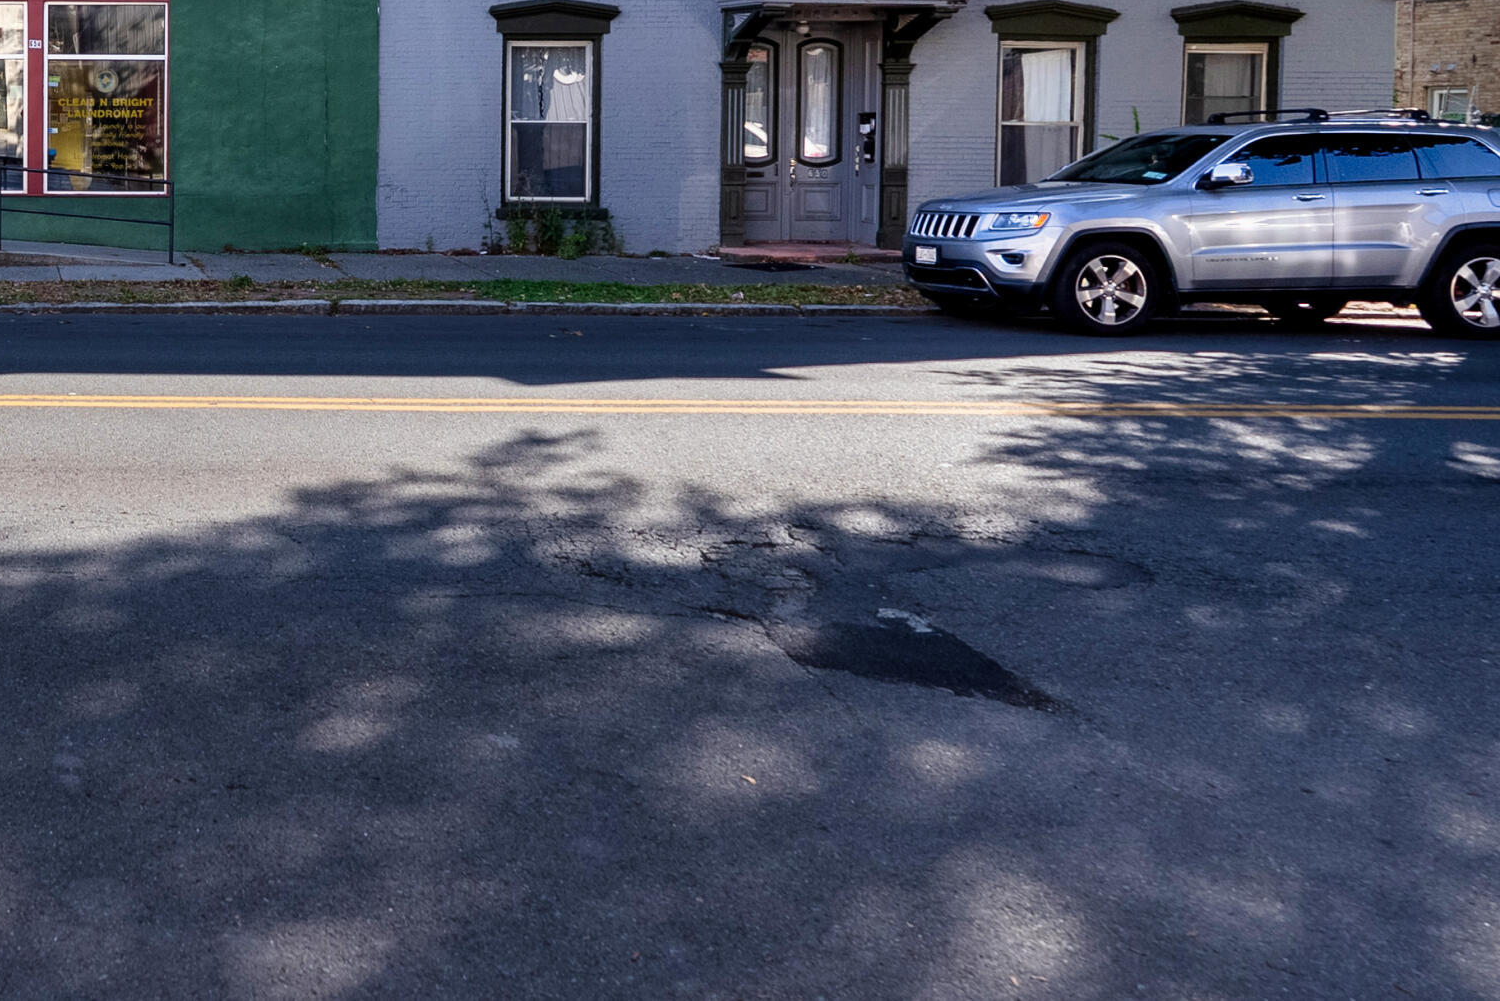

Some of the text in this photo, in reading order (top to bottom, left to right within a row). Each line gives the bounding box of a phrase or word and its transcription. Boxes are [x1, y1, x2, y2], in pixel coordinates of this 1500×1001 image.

[99, 98, 108, 107] N
[112, 98, 154, 107] BRIGHT
[67, 109, 144, 119] LAUNDROMAT
